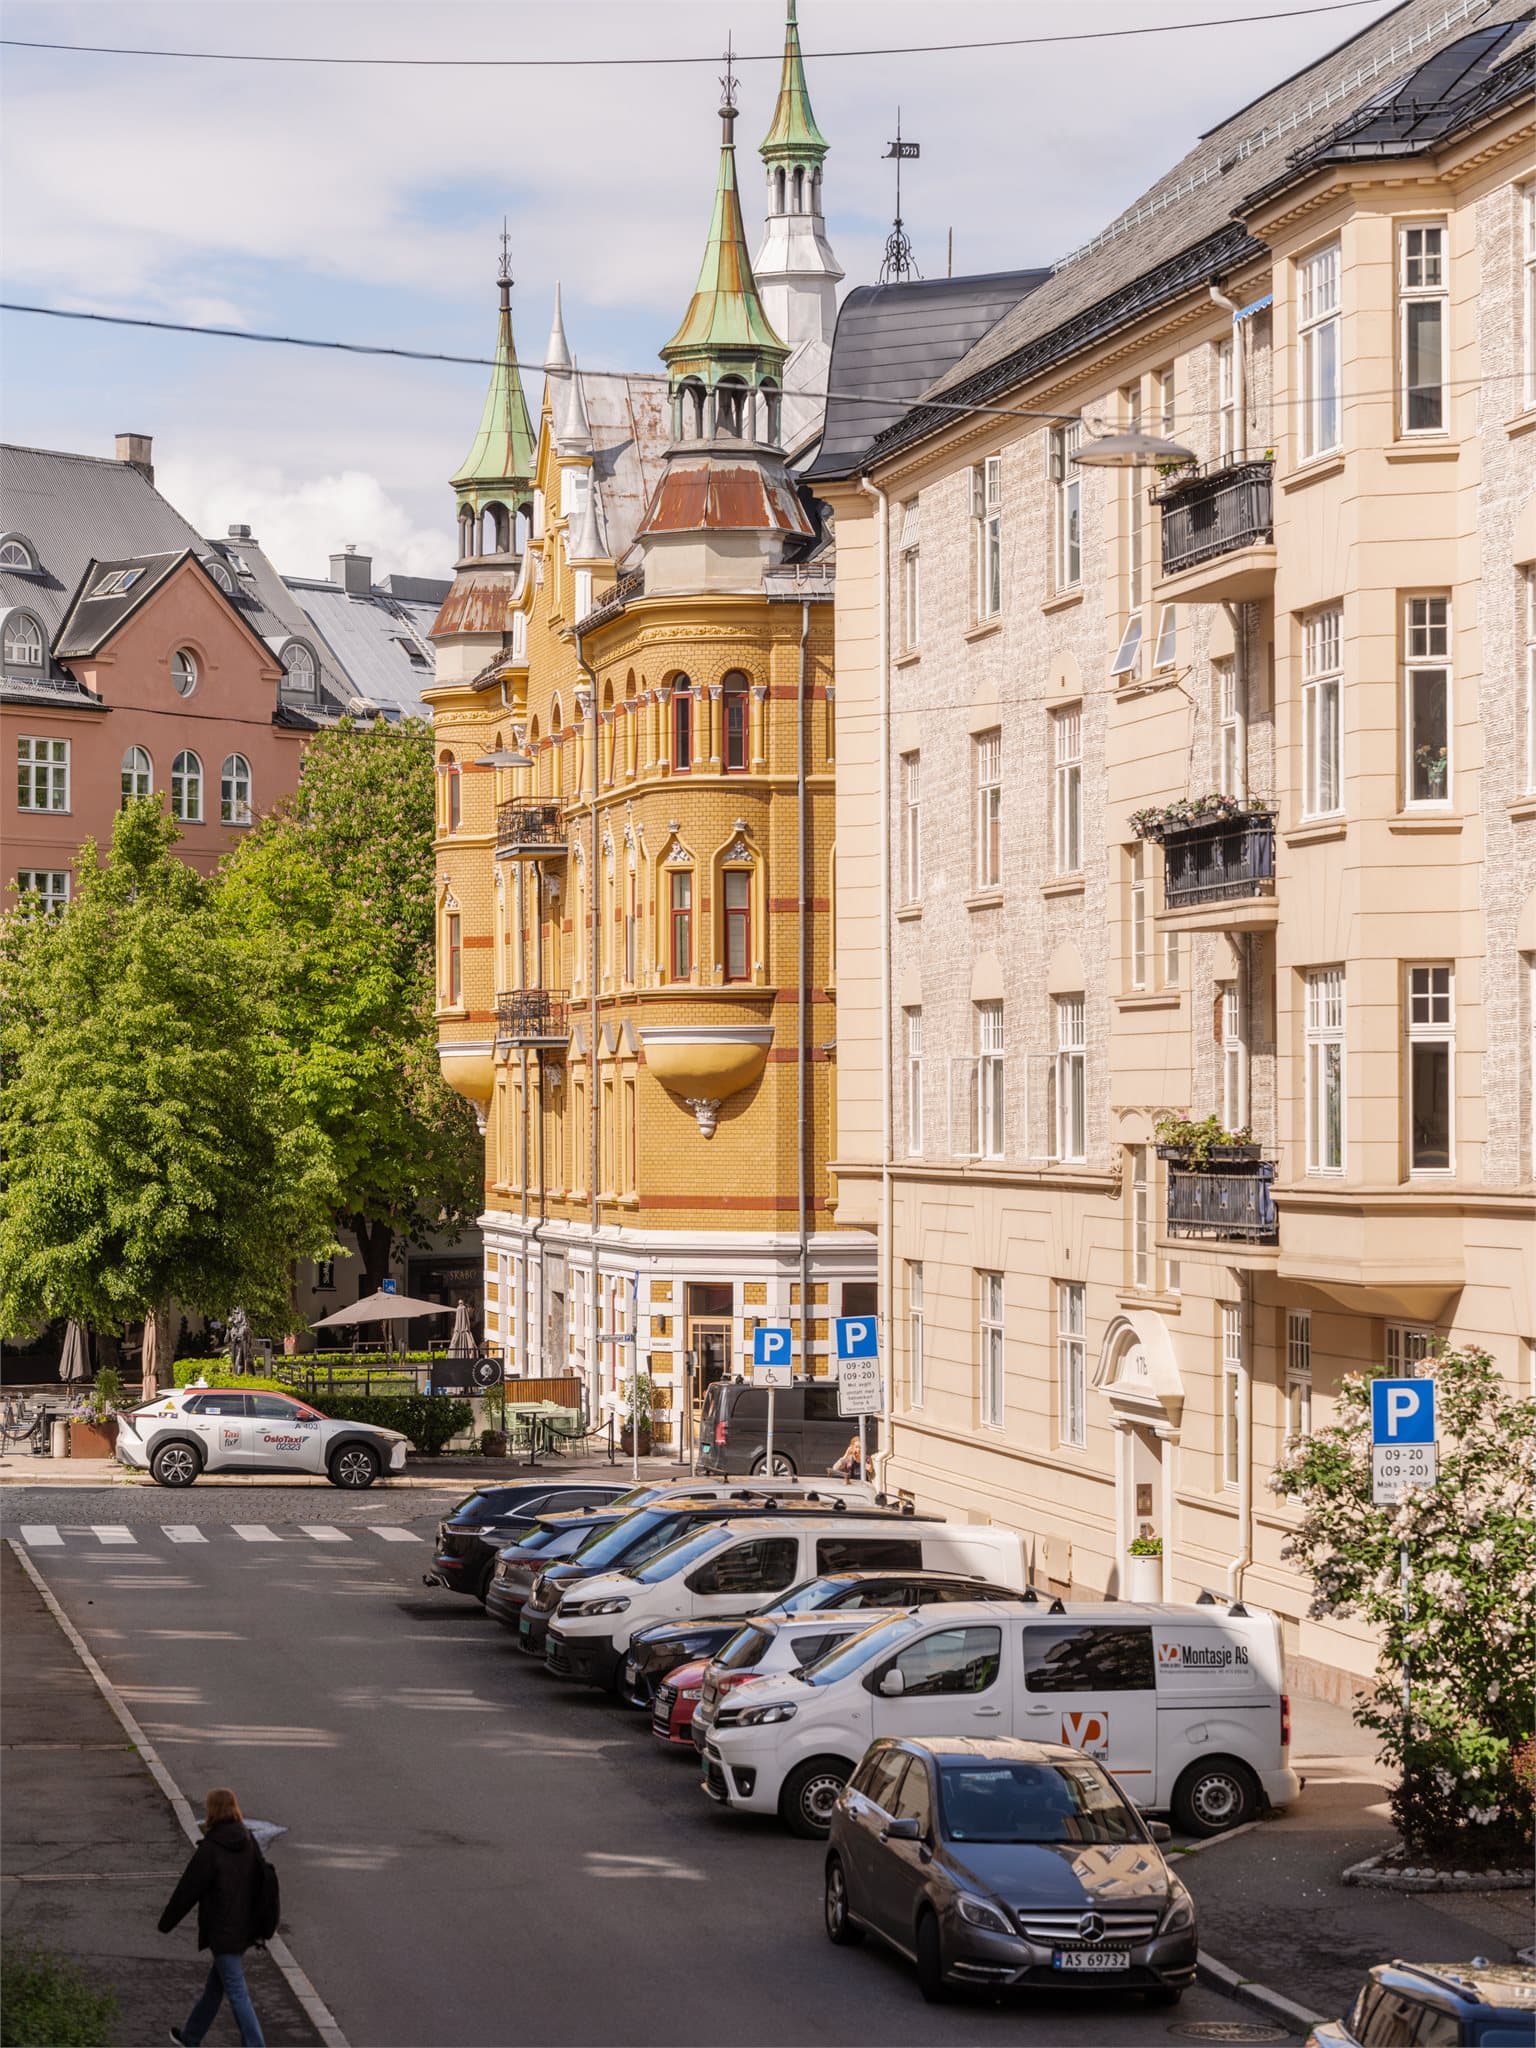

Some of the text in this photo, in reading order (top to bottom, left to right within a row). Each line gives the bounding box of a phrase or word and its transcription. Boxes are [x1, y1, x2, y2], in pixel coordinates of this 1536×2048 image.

[846, 1322, 867, 1354] P
[764, 1333, 784, 1361] P
[846, 1361, 872, 1370] 09-20
[843, 1371, 876, 1380] (09-20)
[1387, 1388, 1420, 1437] P
[223, 1429, 240, 1438] Taxi
[263, 1435, 304, 1443] OsloTaxi
[275, 1443, 301, 1451] 02323
[1385, 1449, 1424, 1460] 09-20
[1380, 1464, 1429, 1477] (09-20)
[1182, 1645, 1232, 1668] Montasje
[1236, 1646, 1249, 1665] AS
[1065, 1954, 1127, 1967] AS 69732
